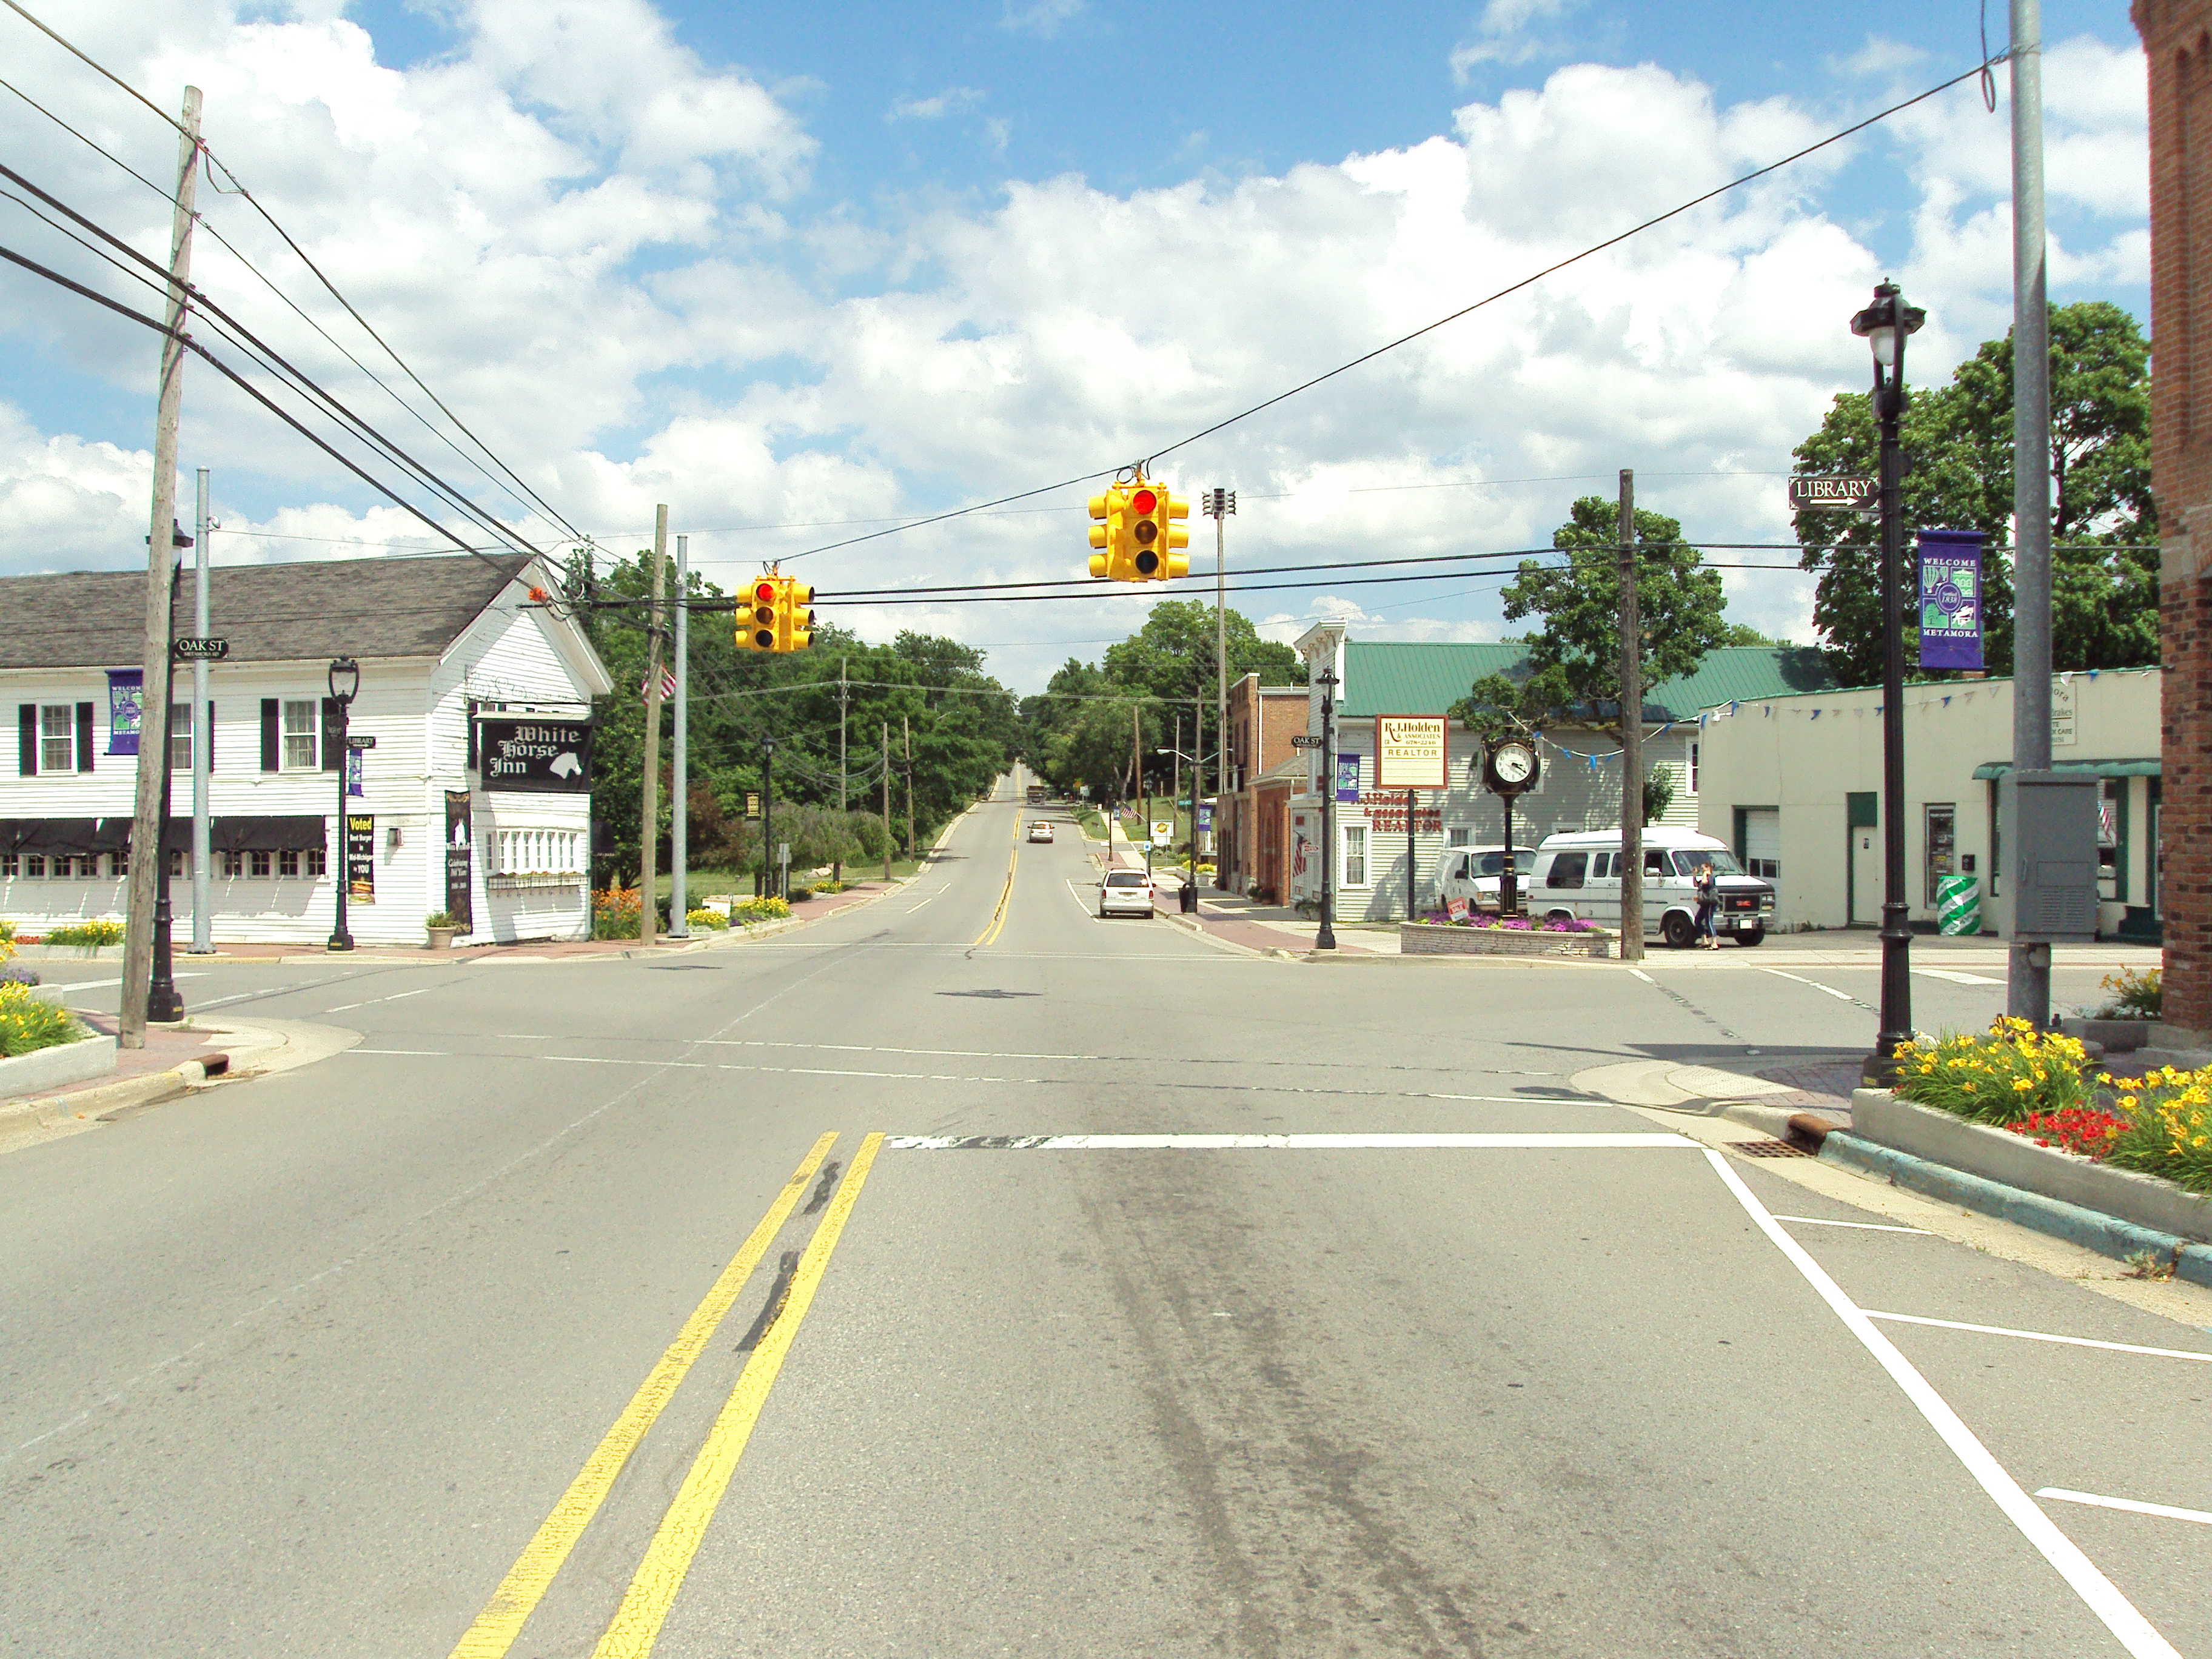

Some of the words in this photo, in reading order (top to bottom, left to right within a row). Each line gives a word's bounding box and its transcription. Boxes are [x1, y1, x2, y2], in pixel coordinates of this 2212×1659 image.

[1796, 480, 1871, 497] LIBRARY
[1923, 558, 1976, 566] WELCOME
[1923, 629, 1978, 637] METAMORA
[179, 640, 207, 651] OAK
[209, 640, 224, 651] ST
[2054, 688, 2068, 702] ora
[514, 726, 581, 745] White
[497, 740, 559, 761] Horse
[489, 757, 526, 777] Inn
[1364, 807, 1372, 817] &
[1373, 807, 1441, 818] assocates
[349, 817, 372, 831] Voted
[358, 865, 369, 873] YOU
